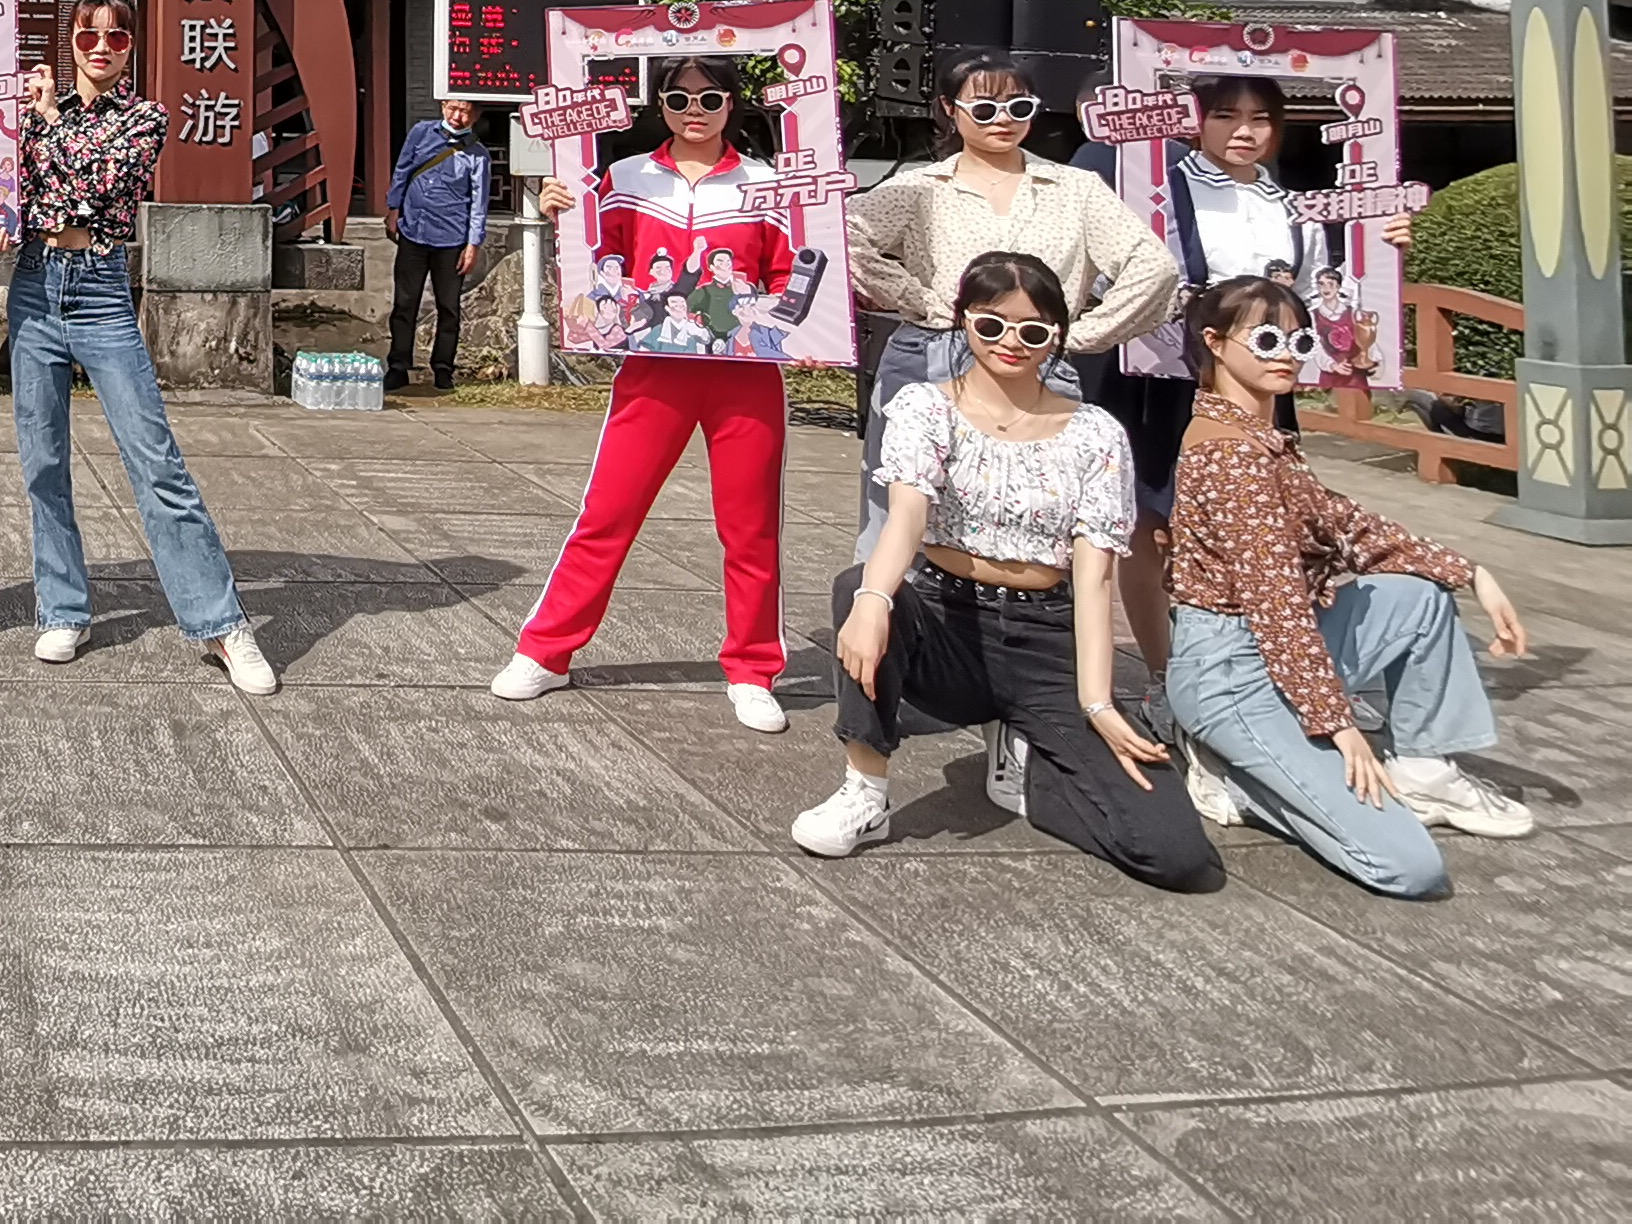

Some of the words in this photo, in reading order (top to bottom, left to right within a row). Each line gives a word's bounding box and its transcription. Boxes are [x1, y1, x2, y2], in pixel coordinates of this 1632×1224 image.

[766, 77, 827, 103] 明月山
[537, 110, 566, 128] THE
[565, 105, 593, 124] AGE
[591, 101, 612, 118] OF
[1106, 113, 1136, 131] THE
[1135, 109, 1166, 127] AGE
[1163, 107, 1186, 124] OF
[1327, 119, 1382, 142] 明月山
[778, 149, 817, 173] DE
[1343, 160, 1379, 185] DE
[739, 172, 856, 212] 万元户
[1291, 183, 1429, 223] 女排精神
